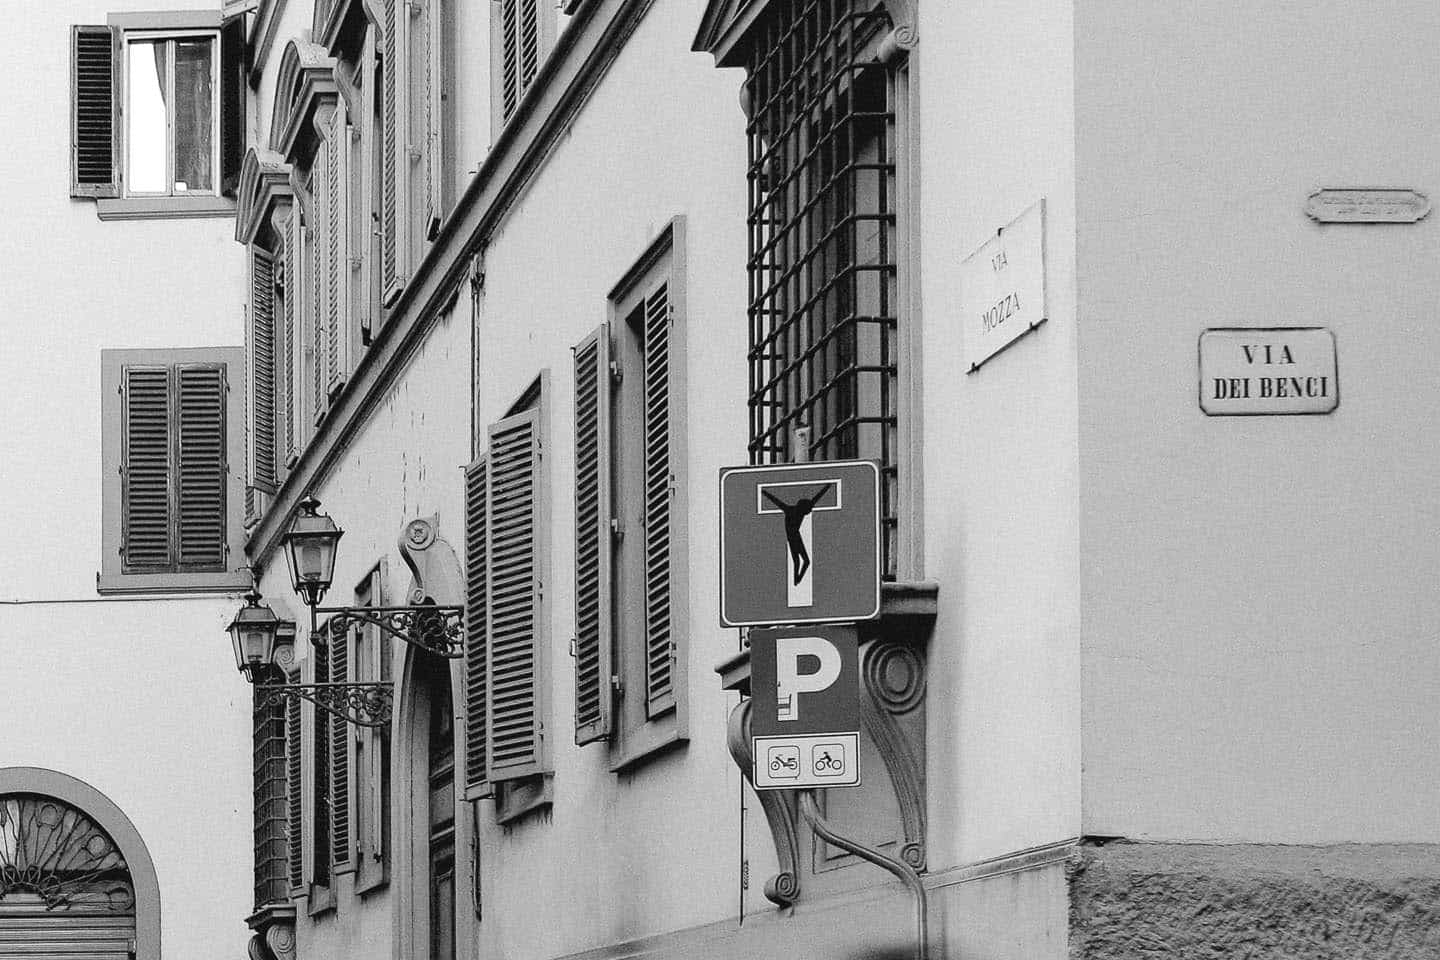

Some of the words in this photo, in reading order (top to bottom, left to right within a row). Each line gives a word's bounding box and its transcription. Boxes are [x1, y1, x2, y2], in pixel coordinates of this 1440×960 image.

[992, 252, 1007, 271] VIA
[982, 292, 1020, 336] MOZZA
[1240, 345, 1296, 364] VIA
[1213, 378, 1250, 399] DEI
[1259, 376, 1328, 398] BENCI
[775, 636, 842, 721] P
